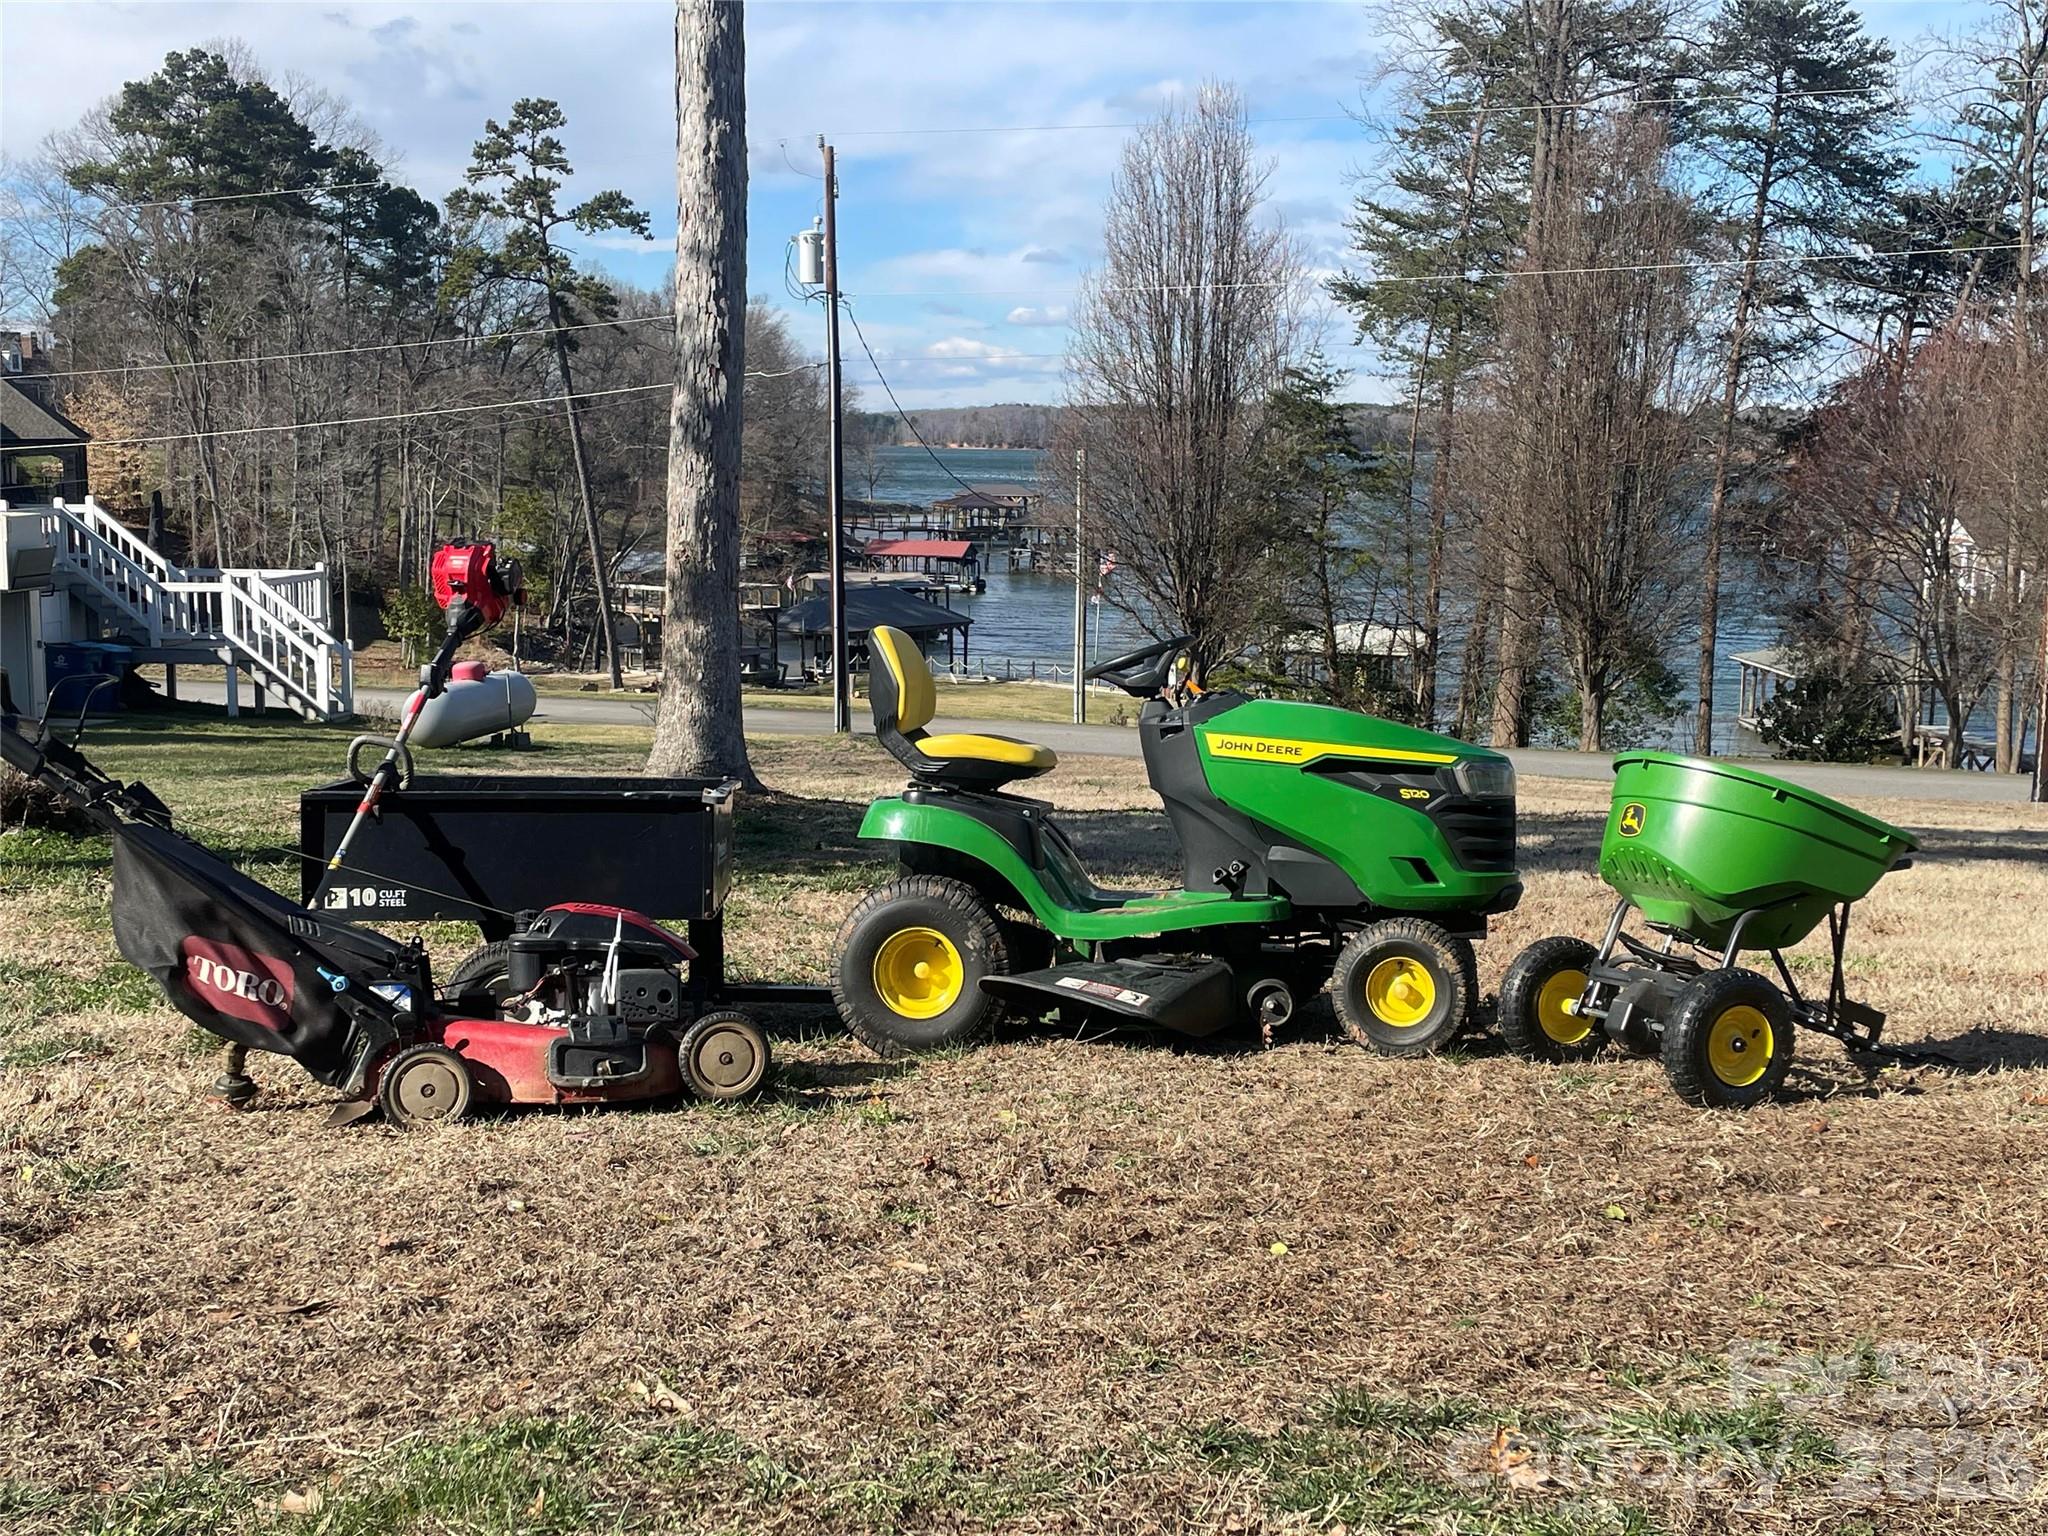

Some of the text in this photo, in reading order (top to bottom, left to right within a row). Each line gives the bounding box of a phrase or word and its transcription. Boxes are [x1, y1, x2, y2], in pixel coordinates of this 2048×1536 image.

[1216, 739, 1303, 756] JOHN DEERE
[1399, 788, 1430, 799] S120
[349, 887, 376, 907] 10
[379, 889, 407, 898] CU.FT
[379, 898, 407, 907] STEEL
[193, 955, 285, 1007] TORO
